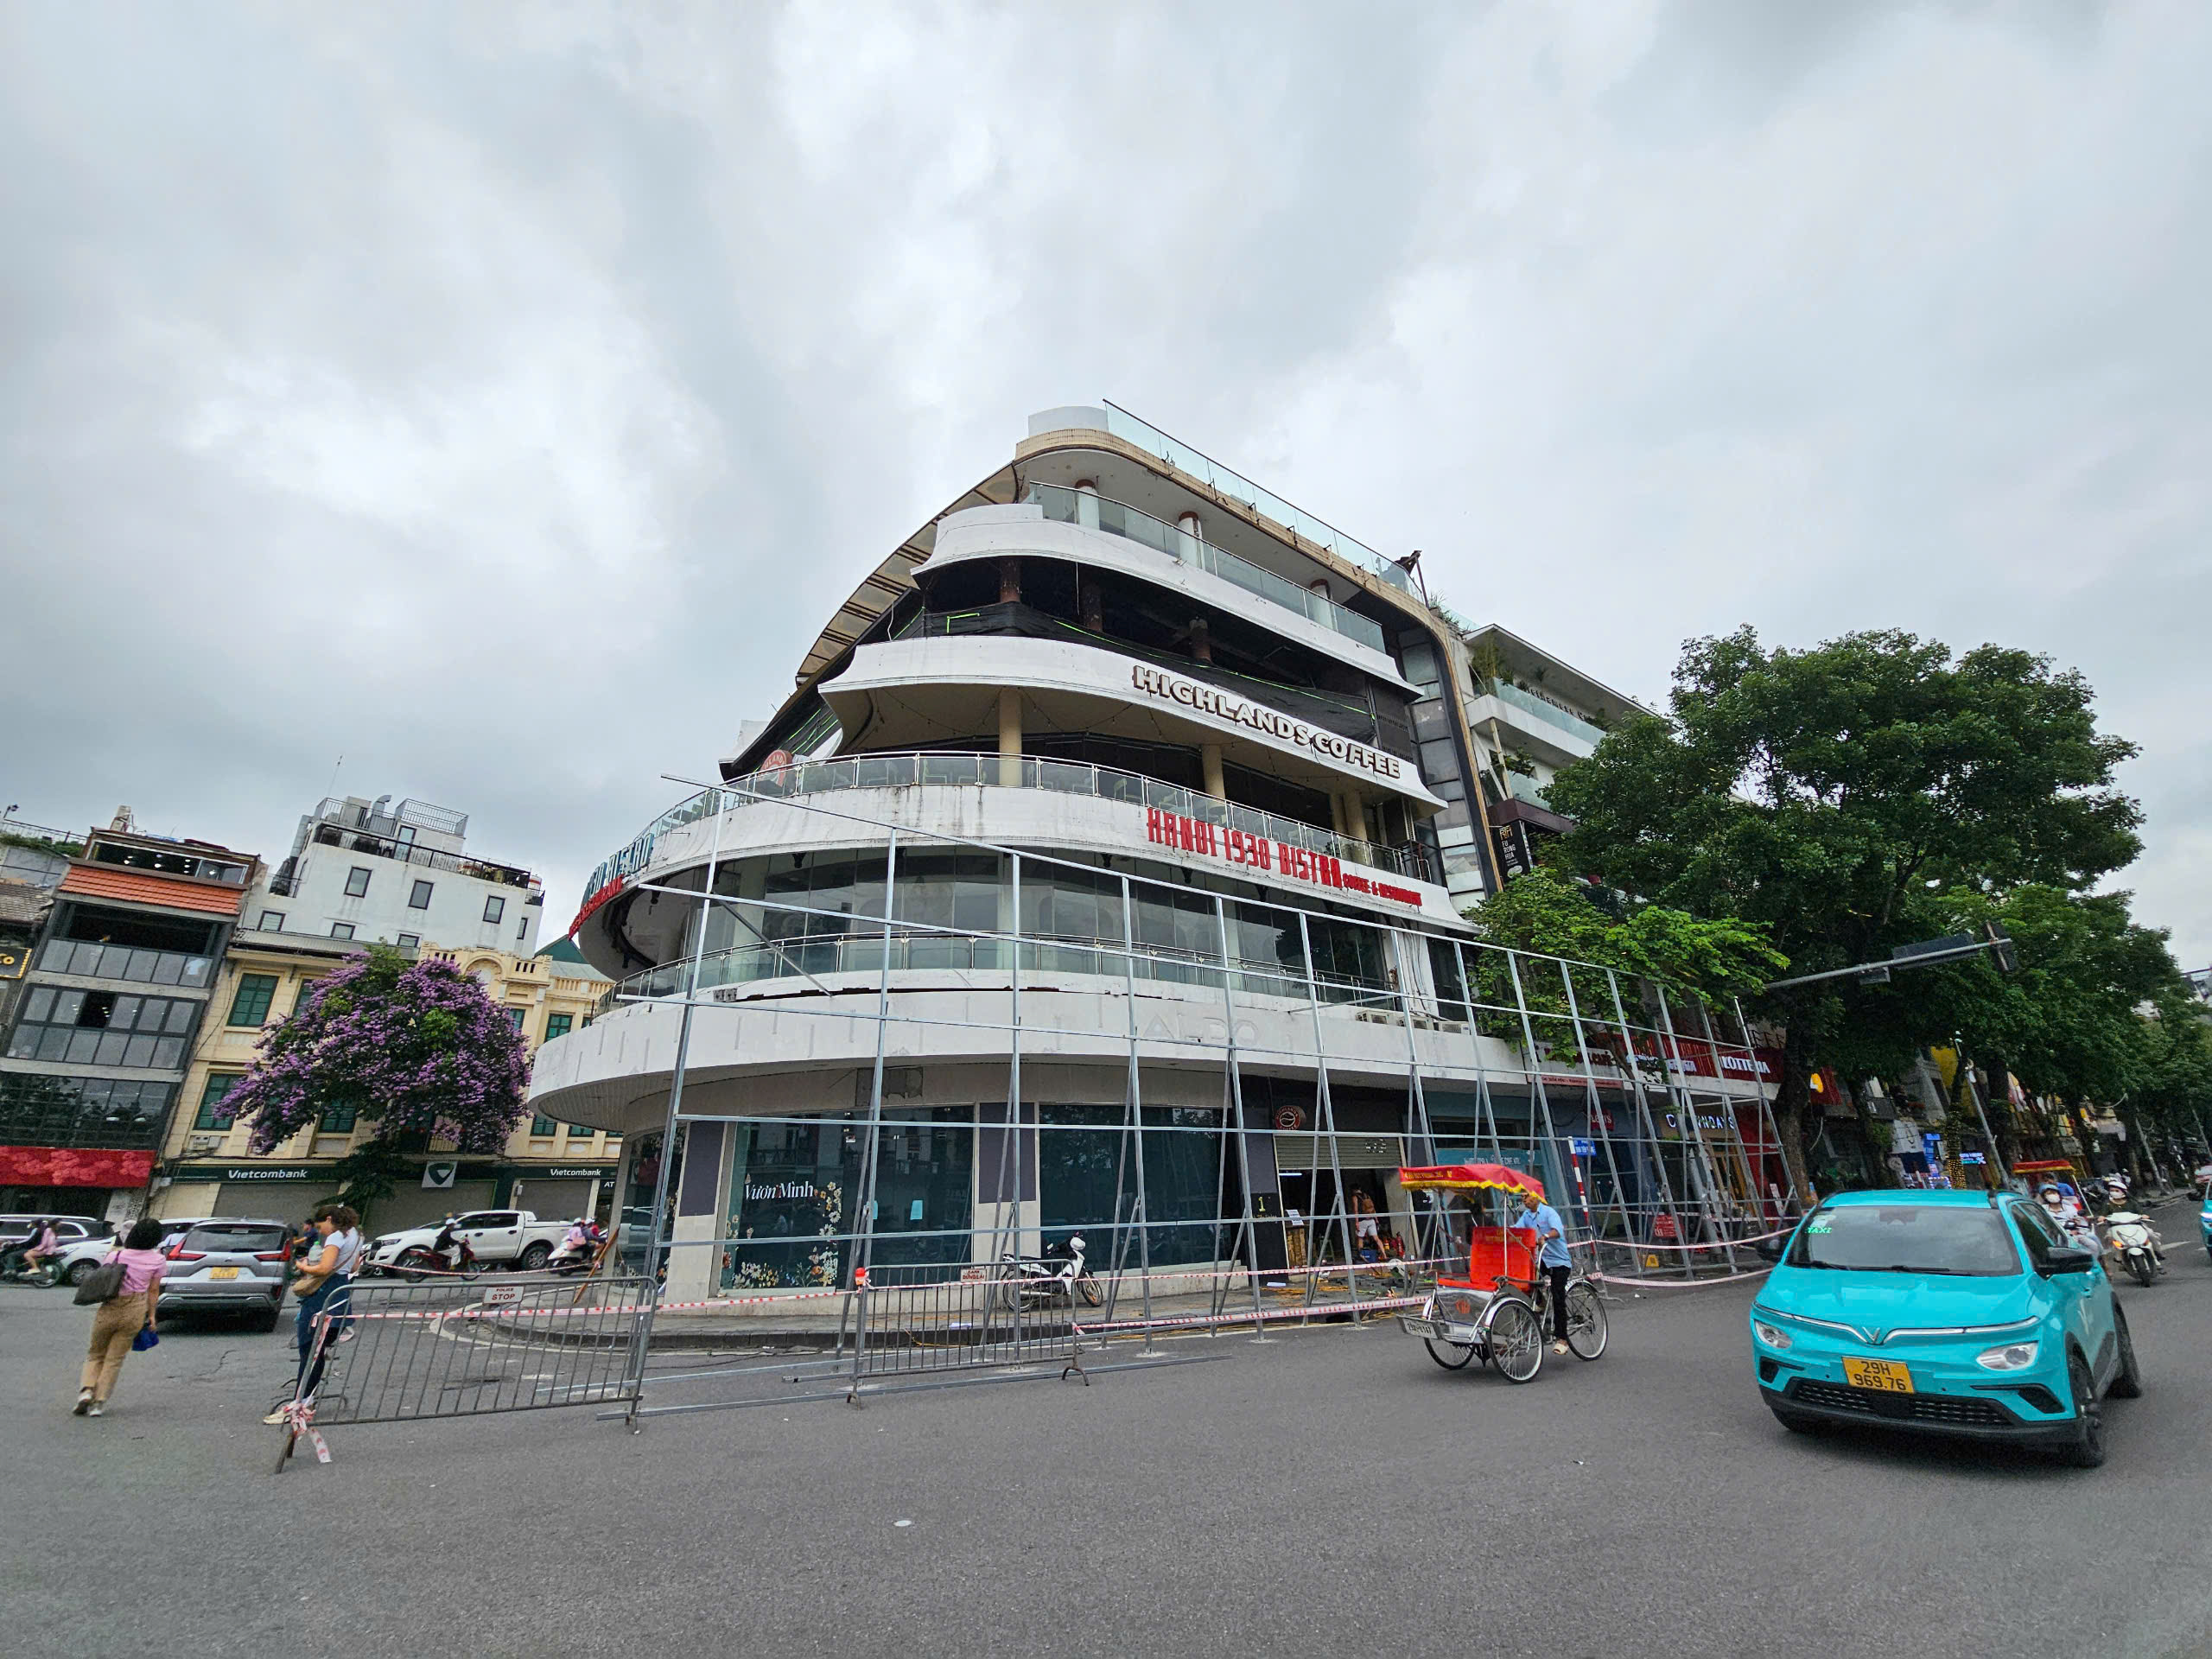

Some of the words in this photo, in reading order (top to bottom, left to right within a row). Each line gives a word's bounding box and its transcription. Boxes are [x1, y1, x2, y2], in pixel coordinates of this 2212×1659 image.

[1133, 665, 1311, 746] HIGHLANDS
[1313, 732, 1401, 779] COFFEE
[1147, 807, 1217, 856] HANOI
[1223, 828, 1271, 870] 1930
[1277, 842, 1343, 888] BISTRO
[1721, 1056, 1771, 1073] LOTTEIA
[228, 1169, 308, 1179] Vietcombank
[779, 1180, 814, 1198] Mình
[1860, 1360, 1891, 1376] 29H
[1854, 1373, 1907, 1391] 969.76
